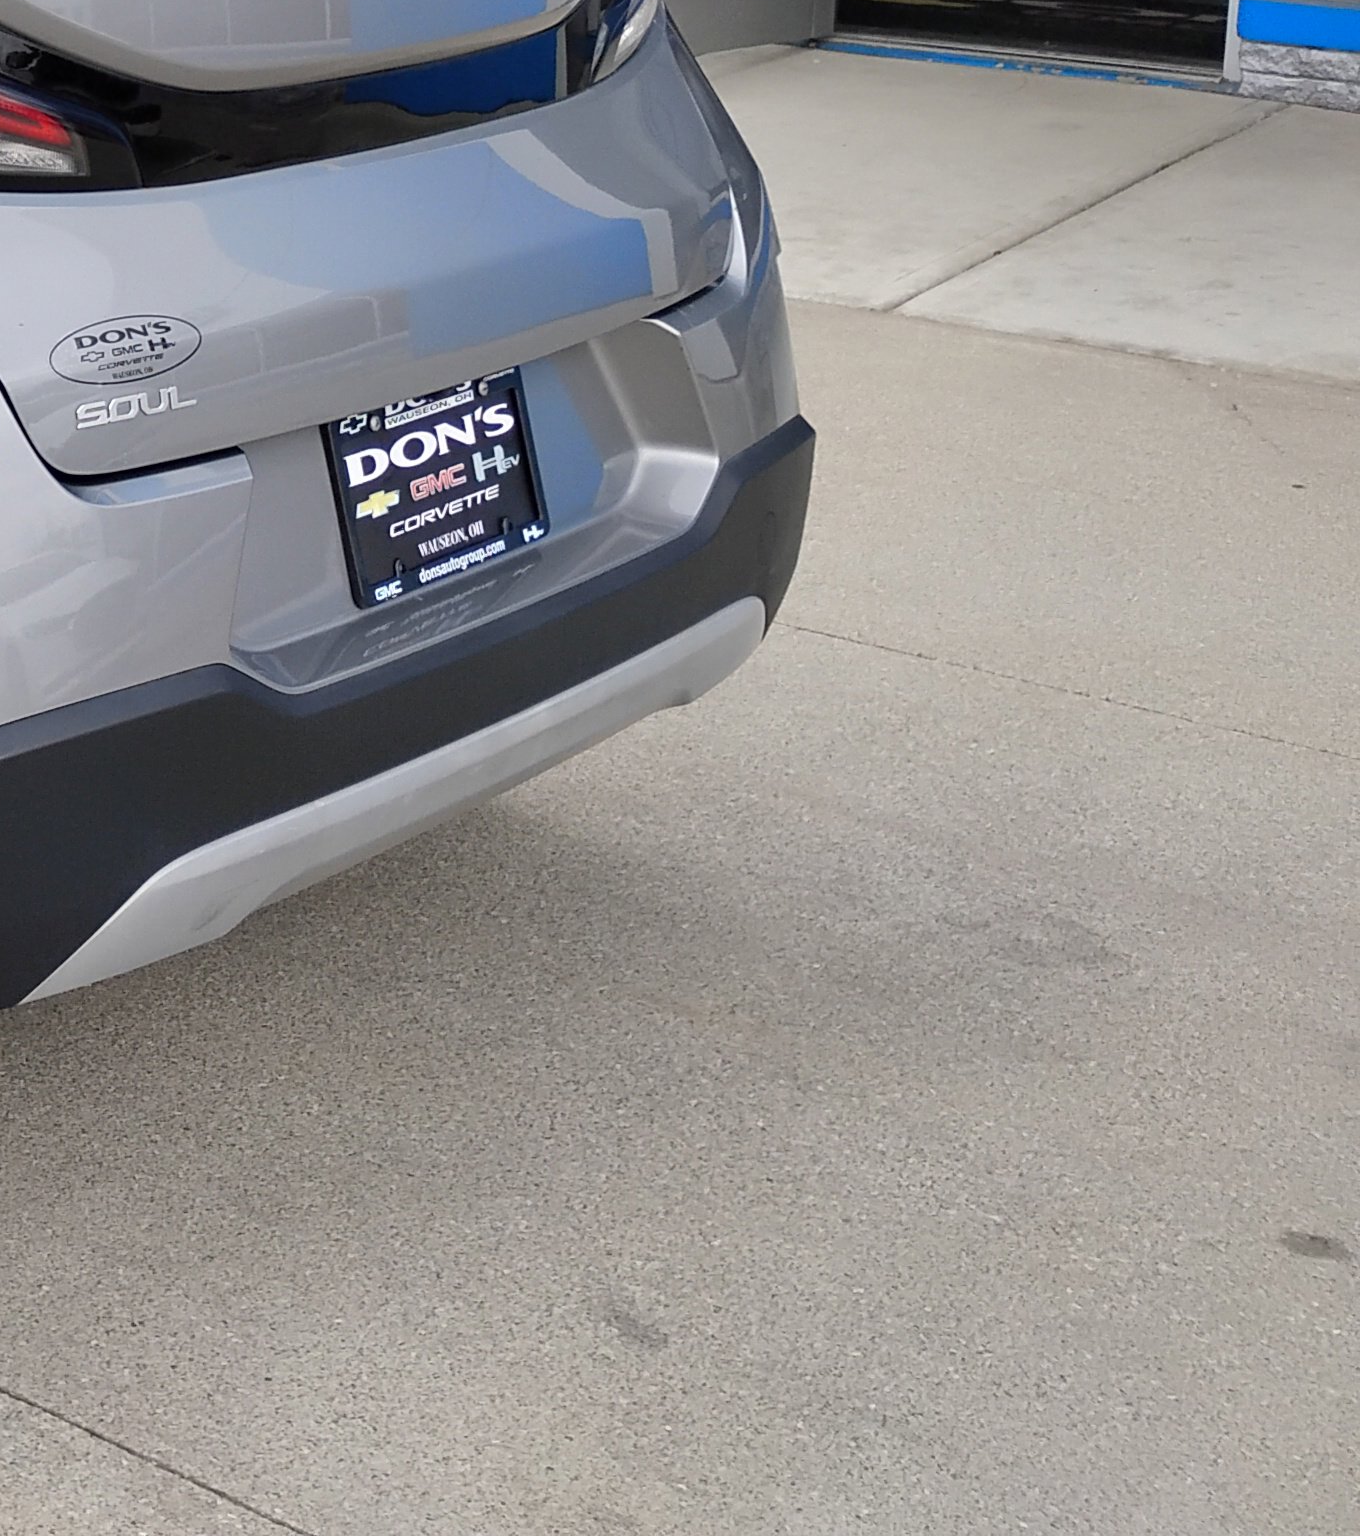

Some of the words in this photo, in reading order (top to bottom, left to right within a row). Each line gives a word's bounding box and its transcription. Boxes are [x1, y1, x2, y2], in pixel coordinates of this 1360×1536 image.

[74, 320, 171, 350] DON'S
[111, 344, 144, 357] GMC
[98, 353, 164, 371] CORVETTE
[76, 385, 198, 430] SOUL
[385, 398, 453, 427] WAUSEON,
[454, 389, 473, 404] OH
[343, 402, 515, 488] DON'S
[409, 463, 468, 502] GMC
[389, 484, 500, 538] CORVETTE
[418, 526, 470, 558] WAUSEON,
[418, 538, 506, 584] donsautogroup.com
[374, 580, 403, 602] GMC
